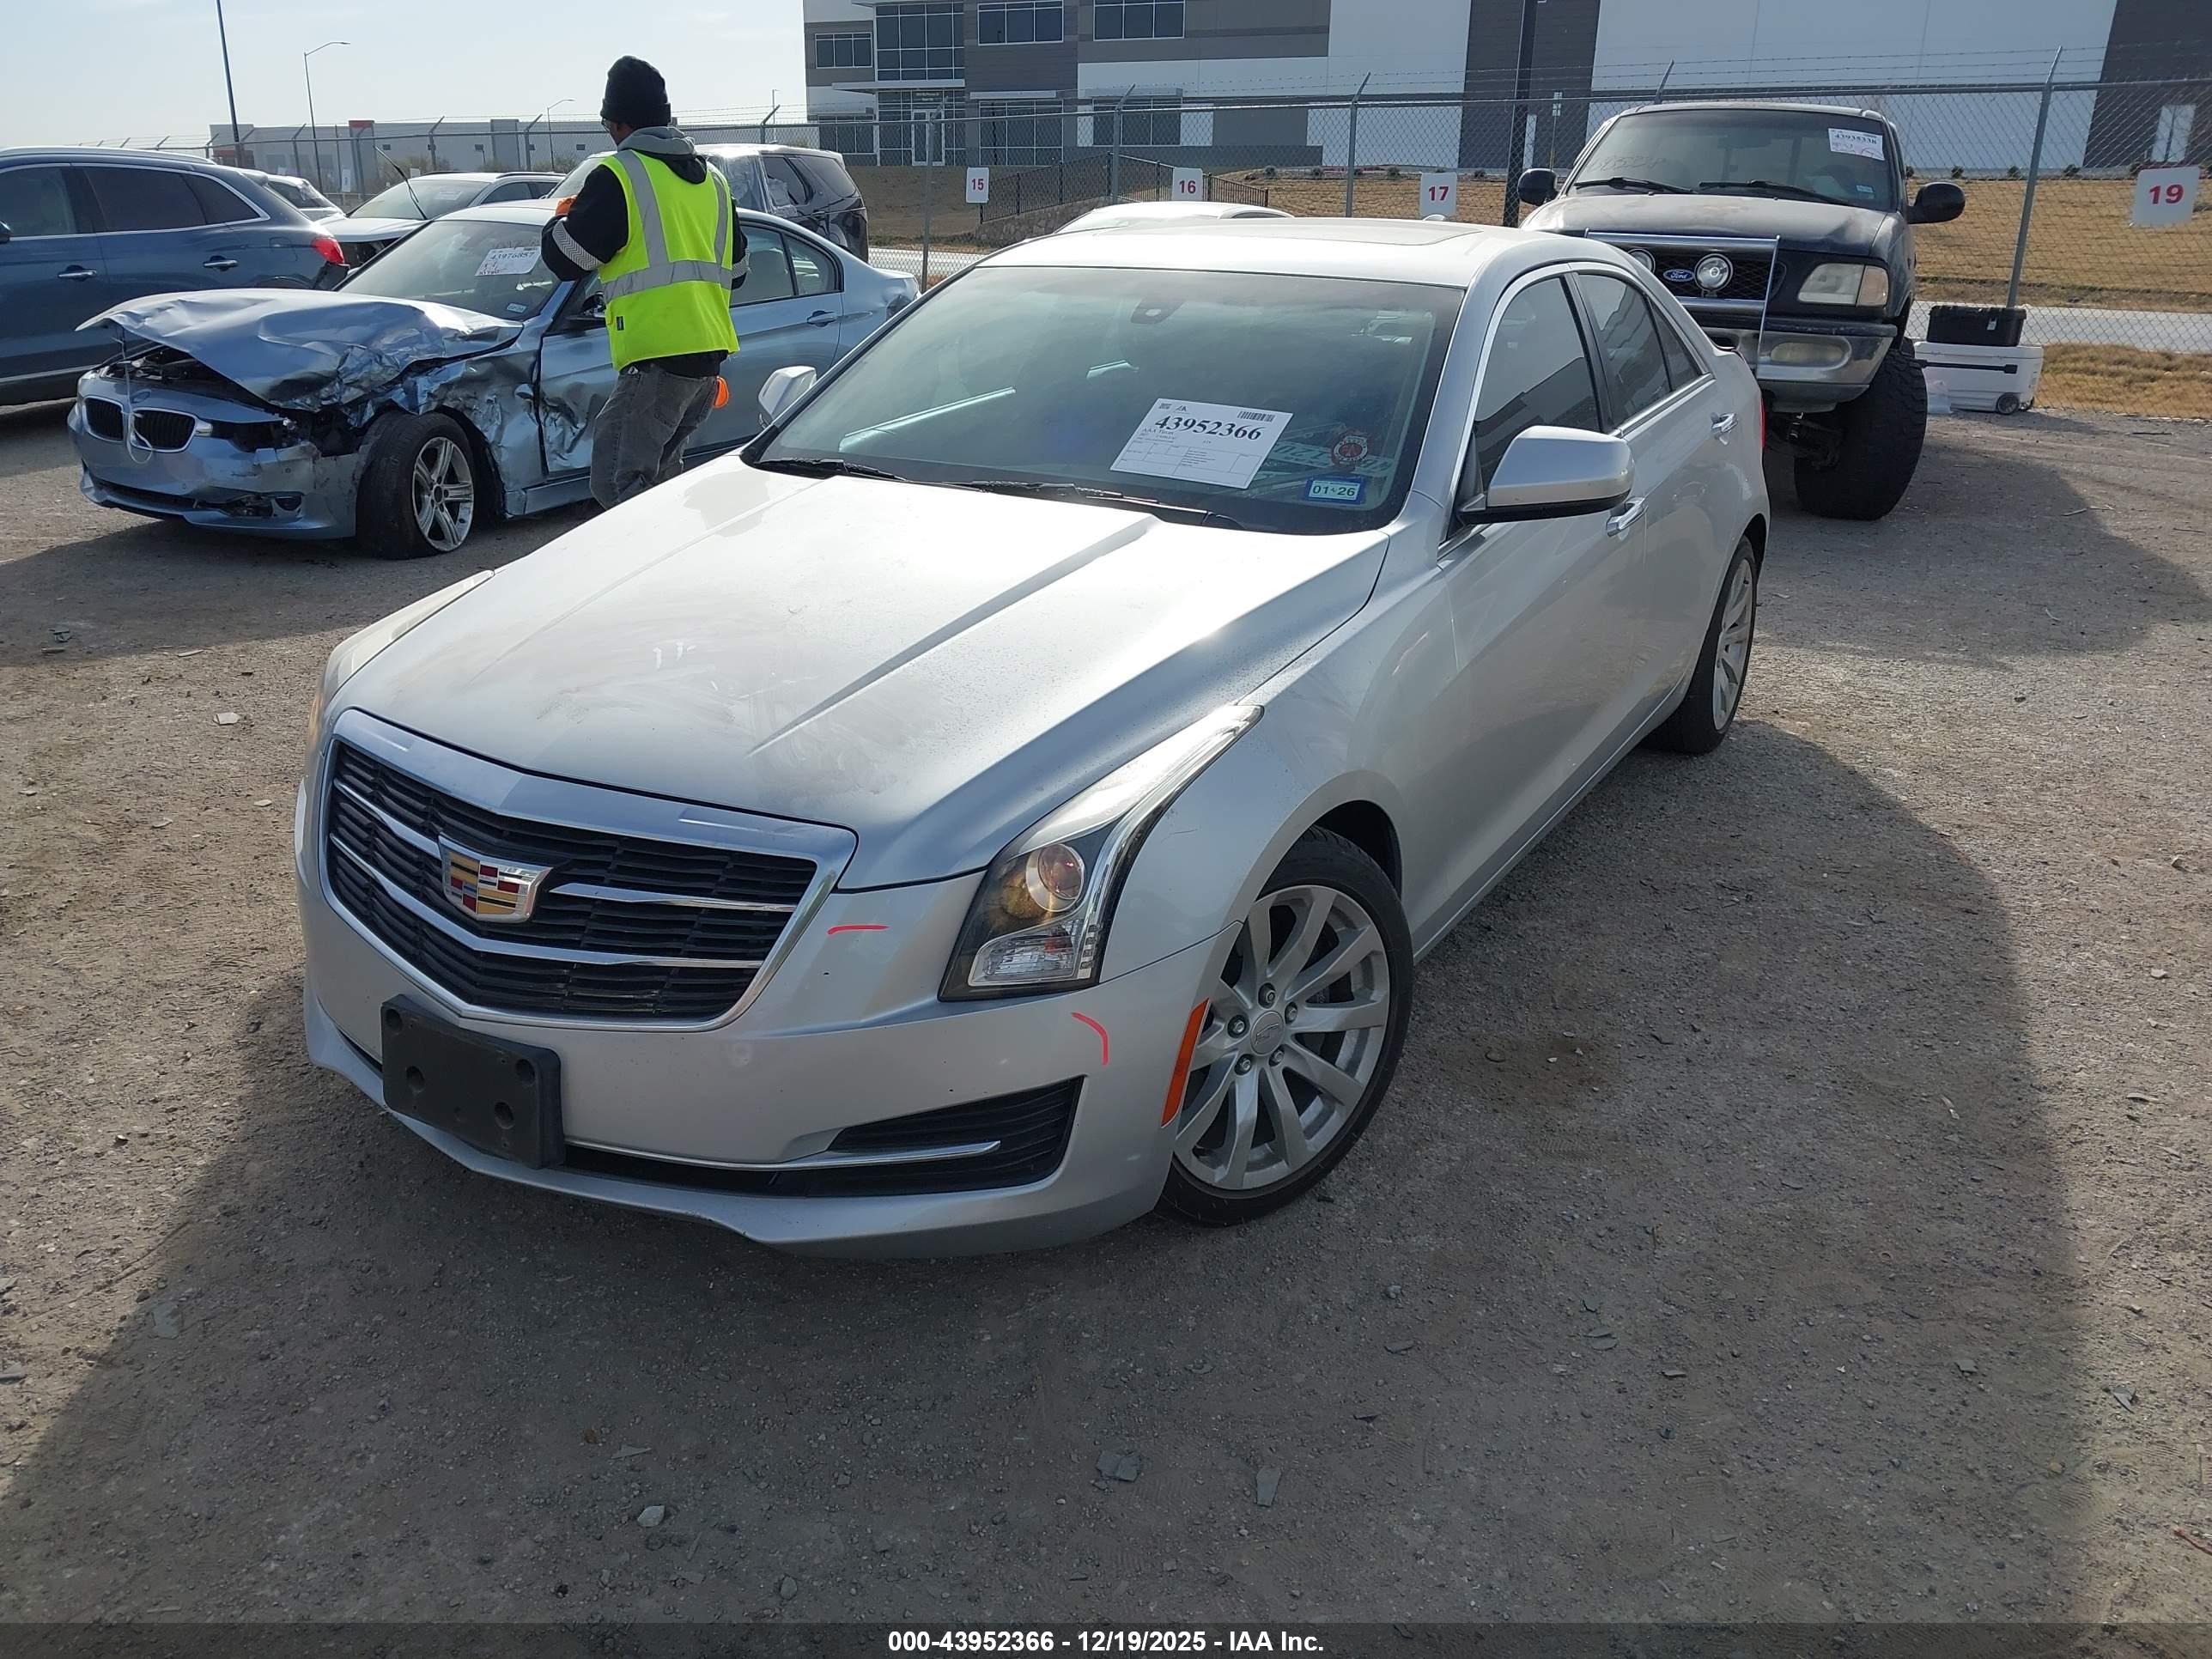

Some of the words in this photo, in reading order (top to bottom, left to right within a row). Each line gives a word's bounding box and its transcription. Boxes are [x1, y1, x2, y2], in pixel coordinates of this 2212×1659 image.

[971, 178, 984, 191] 15
[1179, 179, 1196, 194] 16
[1428, 185, 1449, 201] 17
[2149, 184, 2185, 204] 19
[1154, 416, 1266, 440] 43952366
[1312, 485, 1329, 494] 01
[1337, 487, 1356, 496] 26
